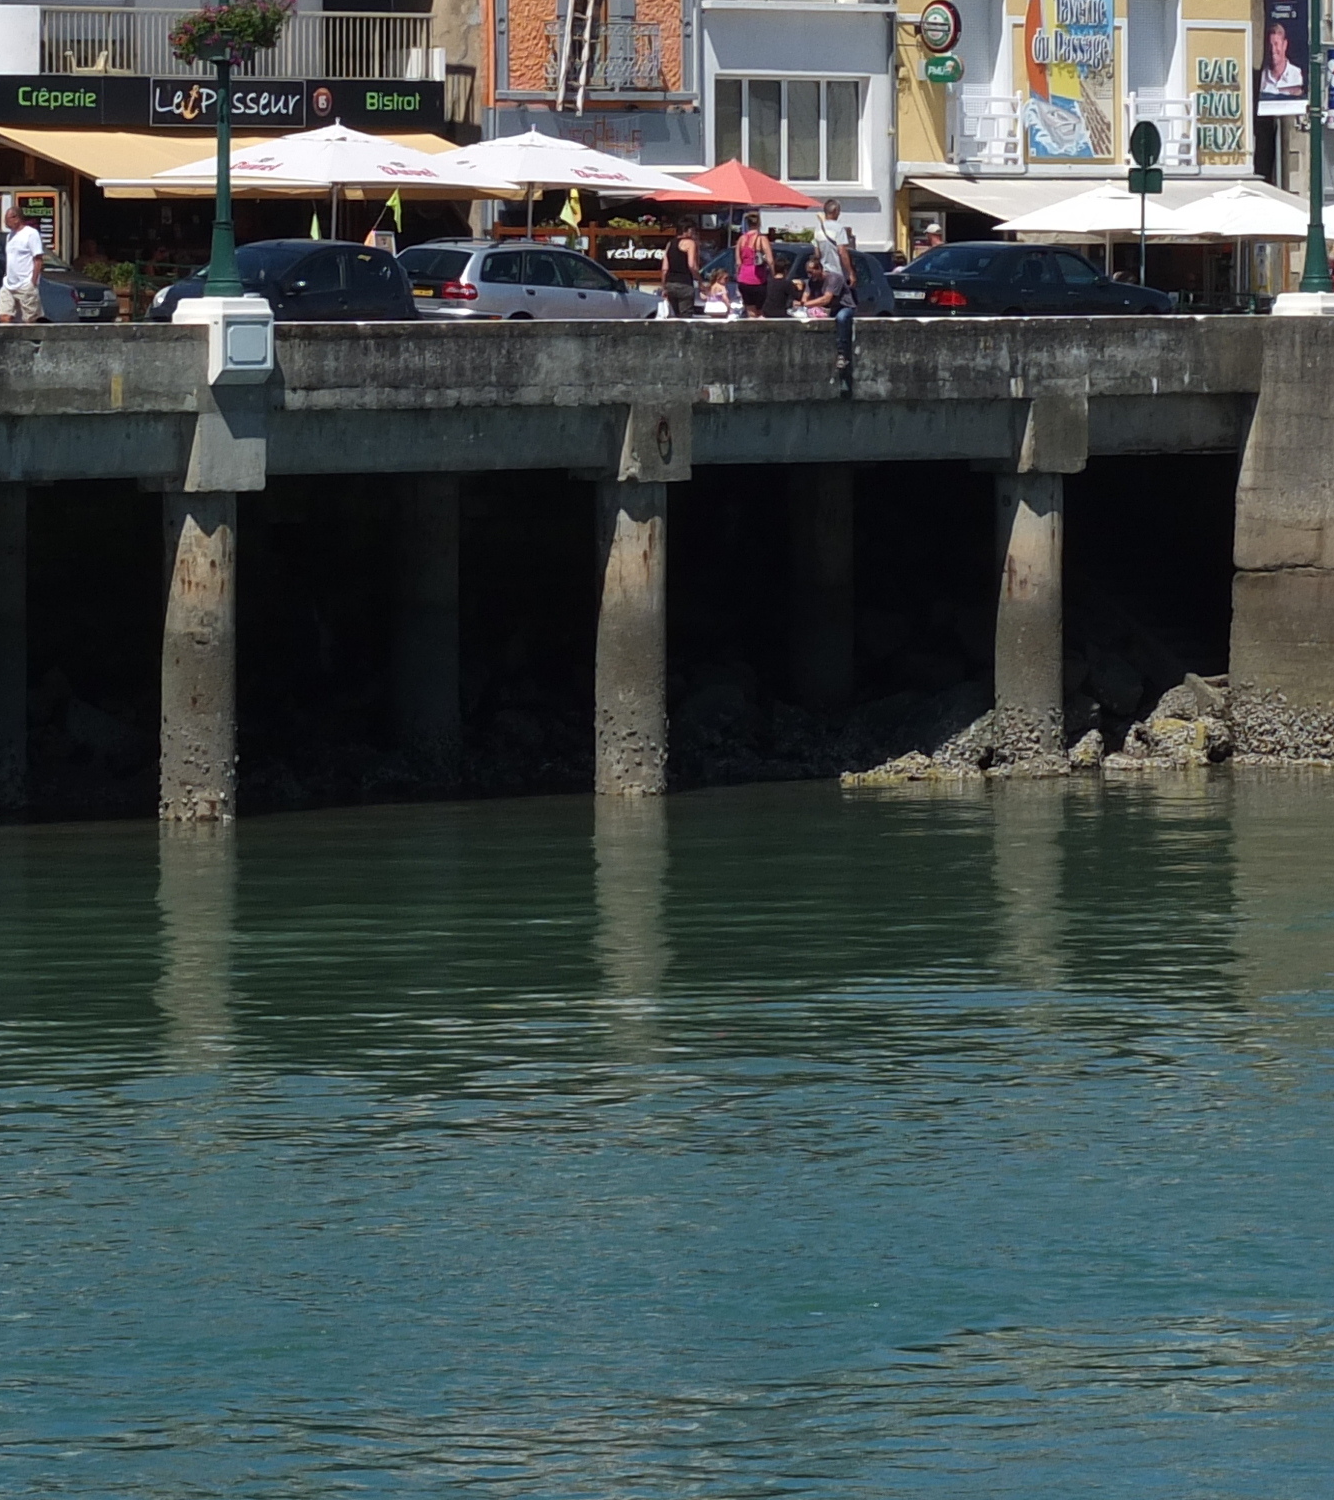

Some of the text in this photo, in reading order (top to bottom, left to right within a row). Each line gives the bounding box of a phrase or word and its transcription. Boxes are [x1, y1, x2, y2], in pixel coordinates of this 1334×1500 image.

[1032, 29, 1110, 71] du Passage
[1195, 56, 1239, 86] BAR
[17, 86, 97, 110] Crêperie
[154, 86, 186, 115] Le
[199, 87, 301, 116] Psseur
[366, 91, 421, 111] Bistrot
[1196, 92, 1242, 119] PMU
[606, 239, 665, 261] restaura
